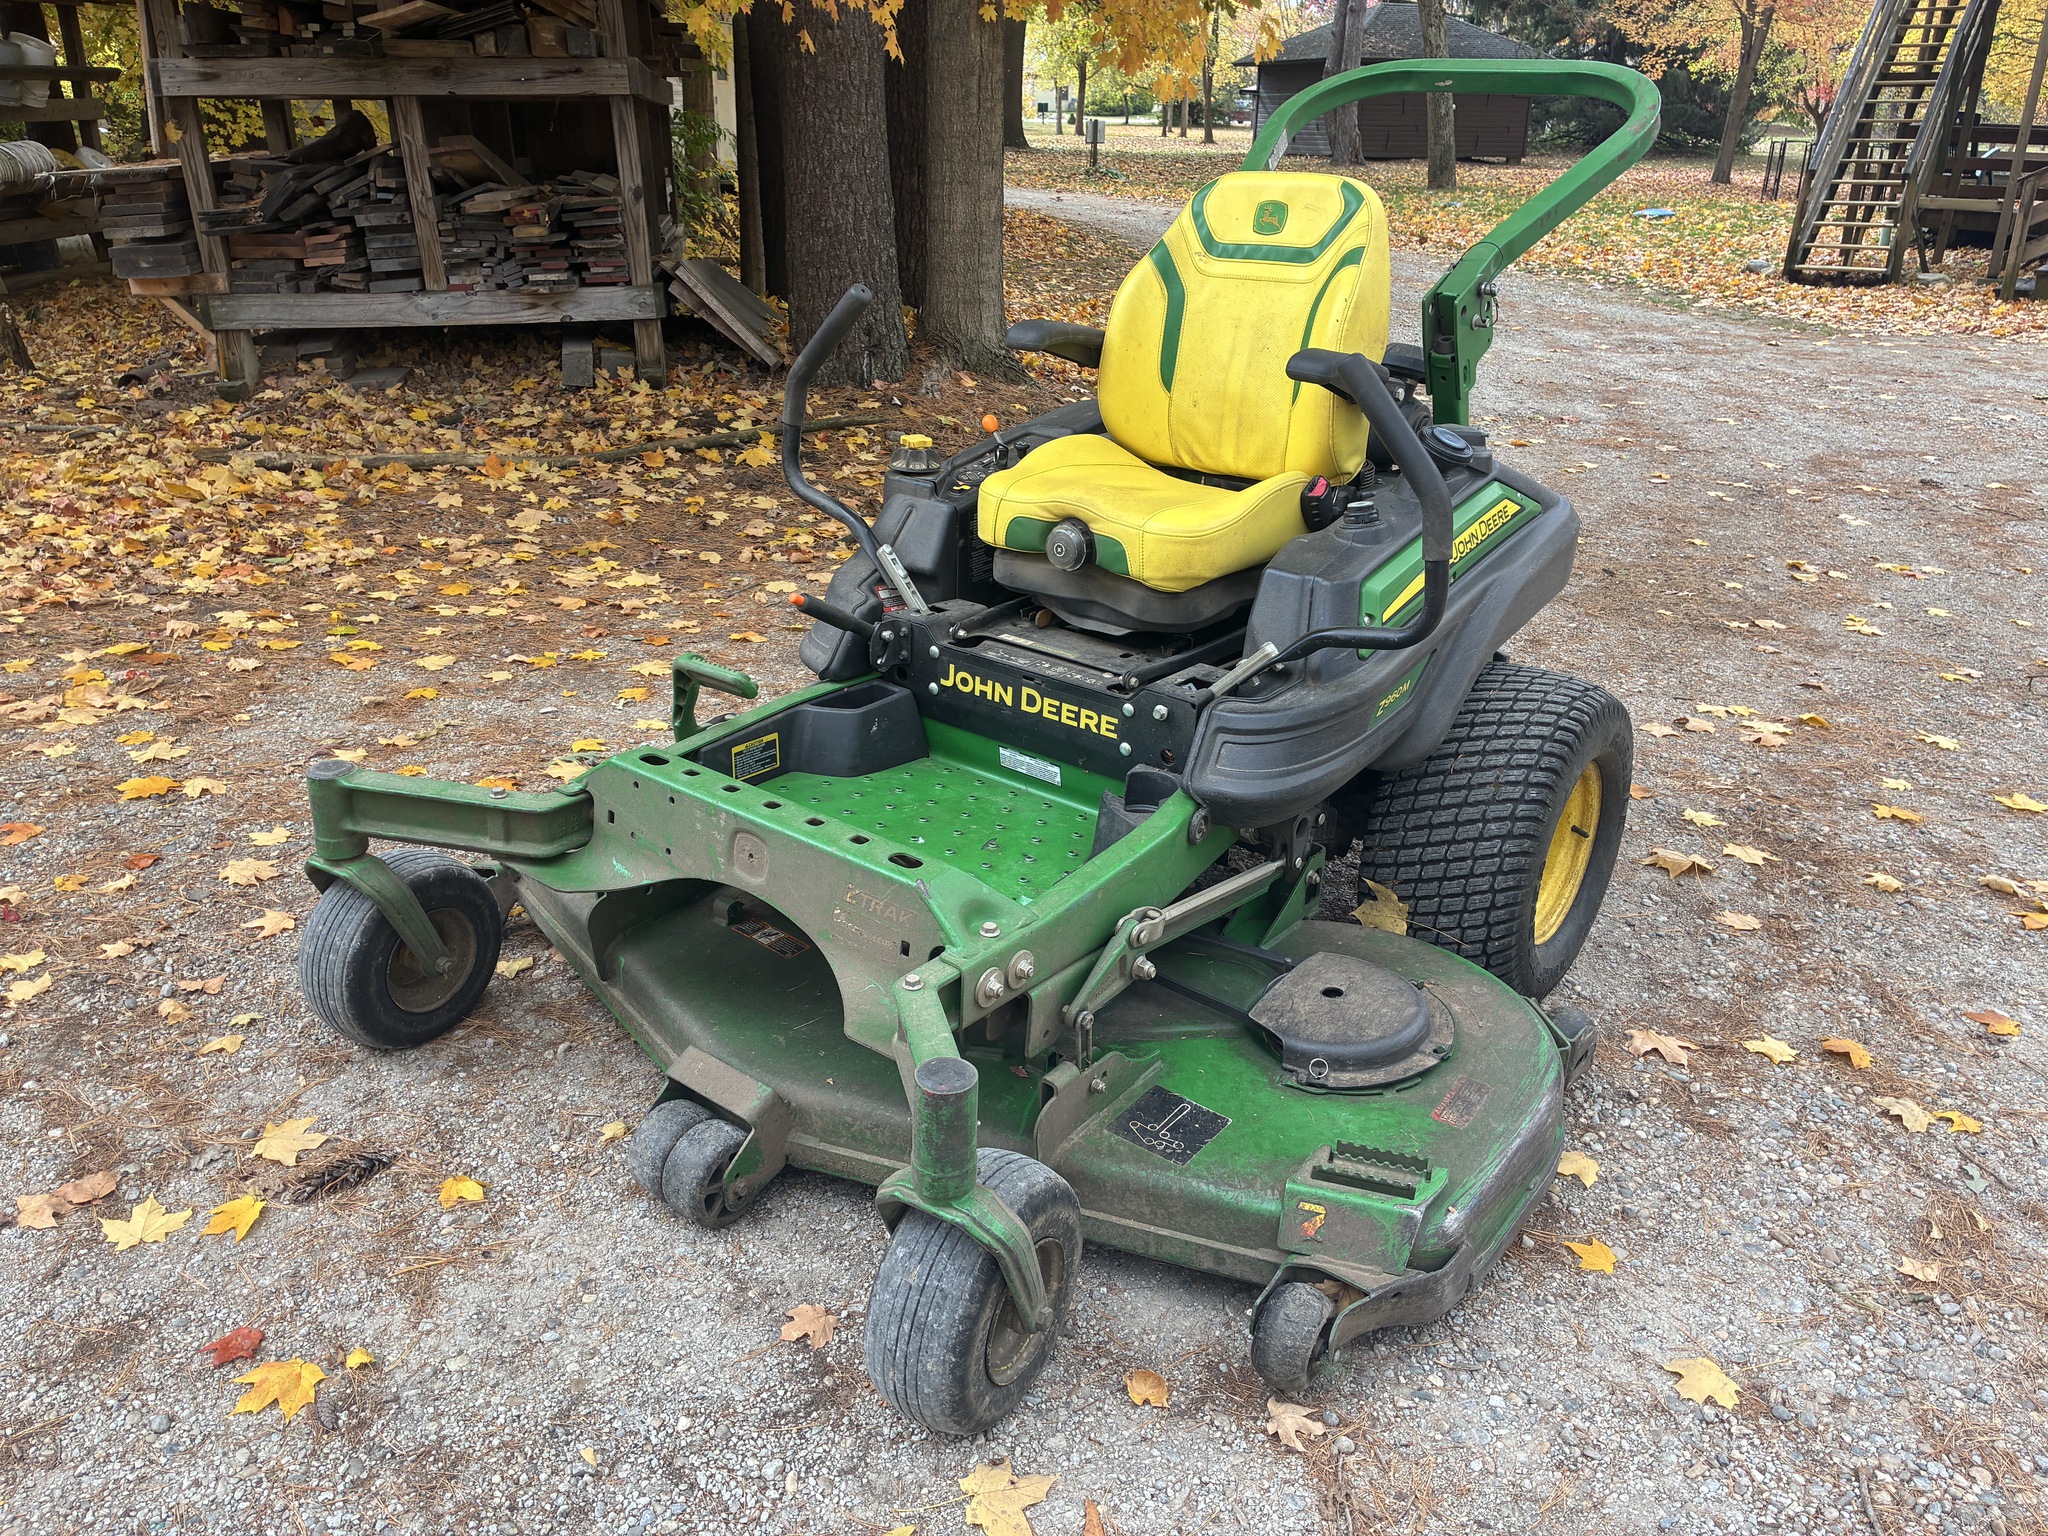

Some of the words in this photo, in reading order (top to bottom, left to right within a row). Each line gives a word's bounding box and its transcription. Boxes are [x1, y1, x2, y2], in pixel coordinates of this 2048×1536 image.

[1453, 529, 1480, 561] JOHN
[1478, 504, 1510, 538] DEERE
[940, 663, 1013, 707] JOHN
[1020, 686, 1119, 740] DEERE
[1375, 679, 1411, 718] Z960M
